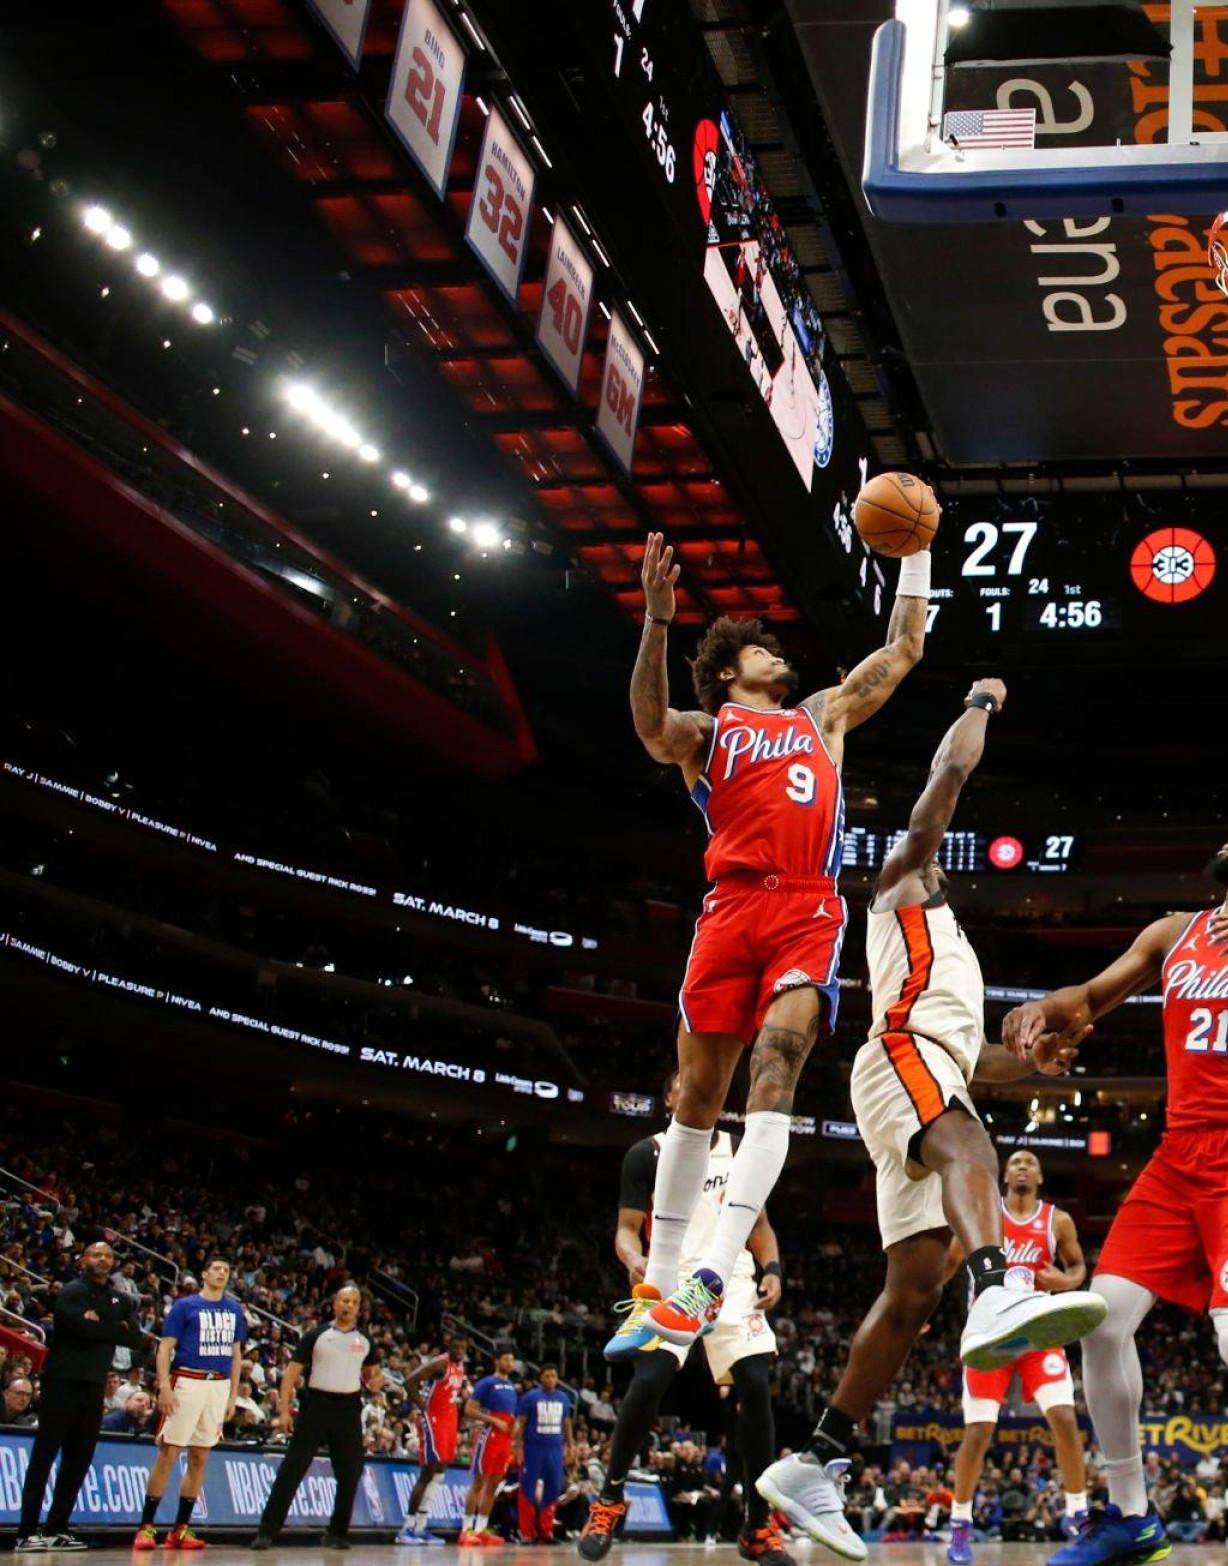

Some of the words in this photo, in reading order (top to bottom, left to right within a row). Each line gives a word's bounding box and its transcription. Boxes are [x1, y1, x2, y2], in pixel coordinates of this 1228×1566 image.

[424, 28, 446, 70] BING
[613, 33, 624, 78] 1
[641, 47, 654, 82] 24
[404, 46, 446, 146] 21
[642, 101, 676, 183] 4:56
[490, 141, 526, 201] HAMILTON
[479, 164, 523, 266] 32
[996, 78, 1127, 333] aena
[547, 277, 583, 355] 40
[961, 521, 1038, 576] 27
[980, 587, 1011, 597] FOULS:
[1028, 578, 1049, 594] 24
[1064, 584, 1082, 595] 1st
[926, 605, 940, 633] 7
[986, 602, 1001, 631] 1
[1040, 601, 1102, 629] 4:56
[720, 725, 814, 780] Phila
[786, 762, 815, 803] 9
[4, 762, 26, 777] RAY
[131, 812, 179, 837] PLEASURE
[191, 836, 217, 852] NIVEA
[234, 852, 255, 864] AND
[256, 858, 295, 875] SPECIAL
[296, 869, 327, 883] GUEST
[1044, 836, 1074, 859] 27
[393, 892, 426, 911] SAT.
[429, 901, 487, 927] MARCH
[488, 917, 499, 930] 8
[98, 972, 154, 998] PLEASURE
[171, 994, 202, 1012] NIVEA
[209, 1007, 230, 1020] AND
[231, 1013, 270, 1032] SPECIAL
[271, 1025, 300, 1041] GUEST
[360, 1047, 399, 1067] SAT.
[402, 1055, 469, 1081] MARCH
[473, 1070, 486, 1083] 8
